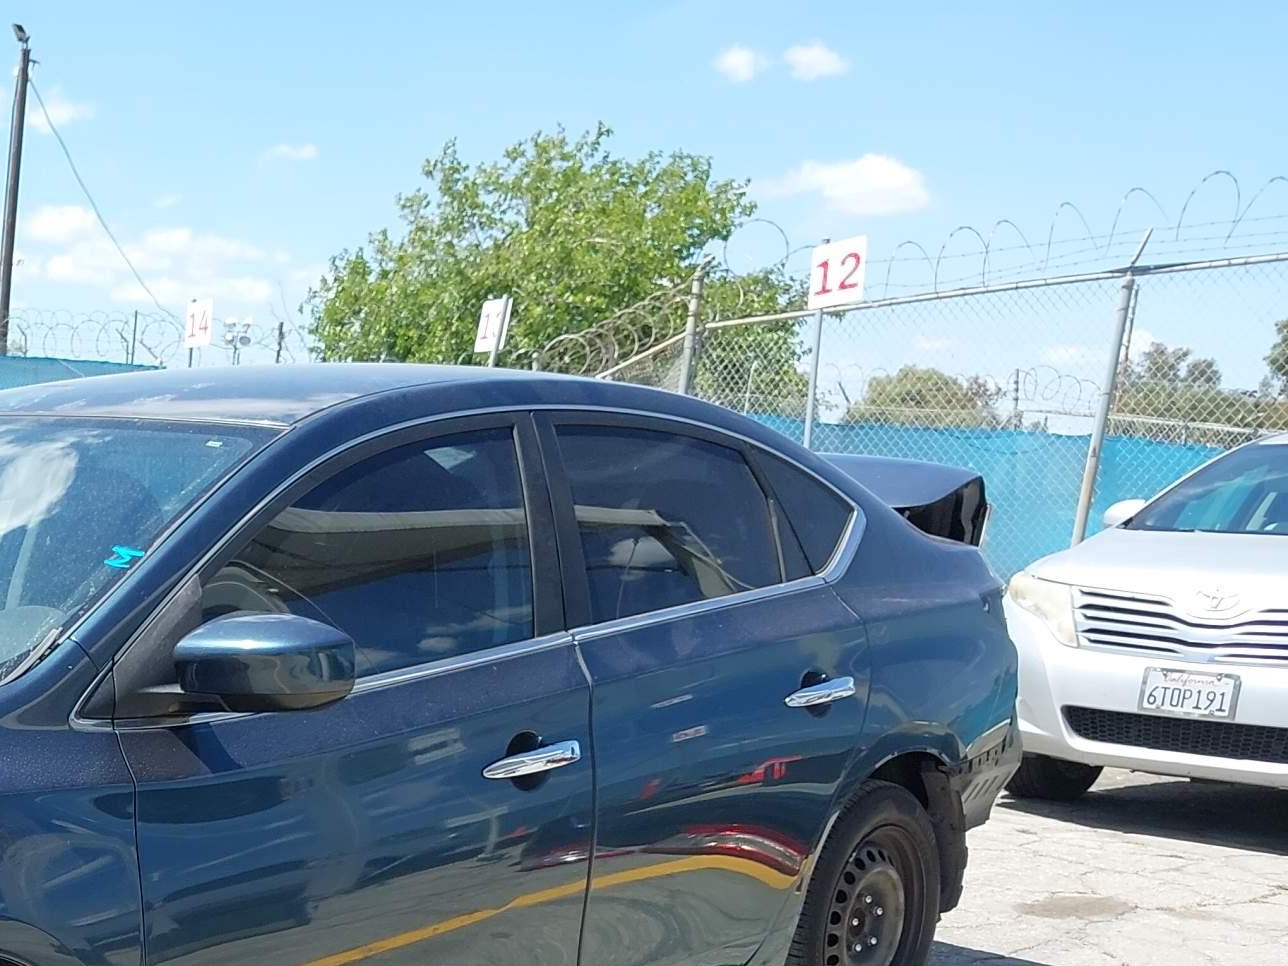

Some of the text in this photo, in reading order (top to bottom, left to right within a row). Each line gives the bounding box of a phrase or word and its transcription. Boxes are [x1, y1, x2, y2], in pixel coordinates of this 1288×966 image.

[814, 251, 860, 296] 12
[187, 310, 208, 337] 14
[1146, 685, 1226, 712] 6TOP191
